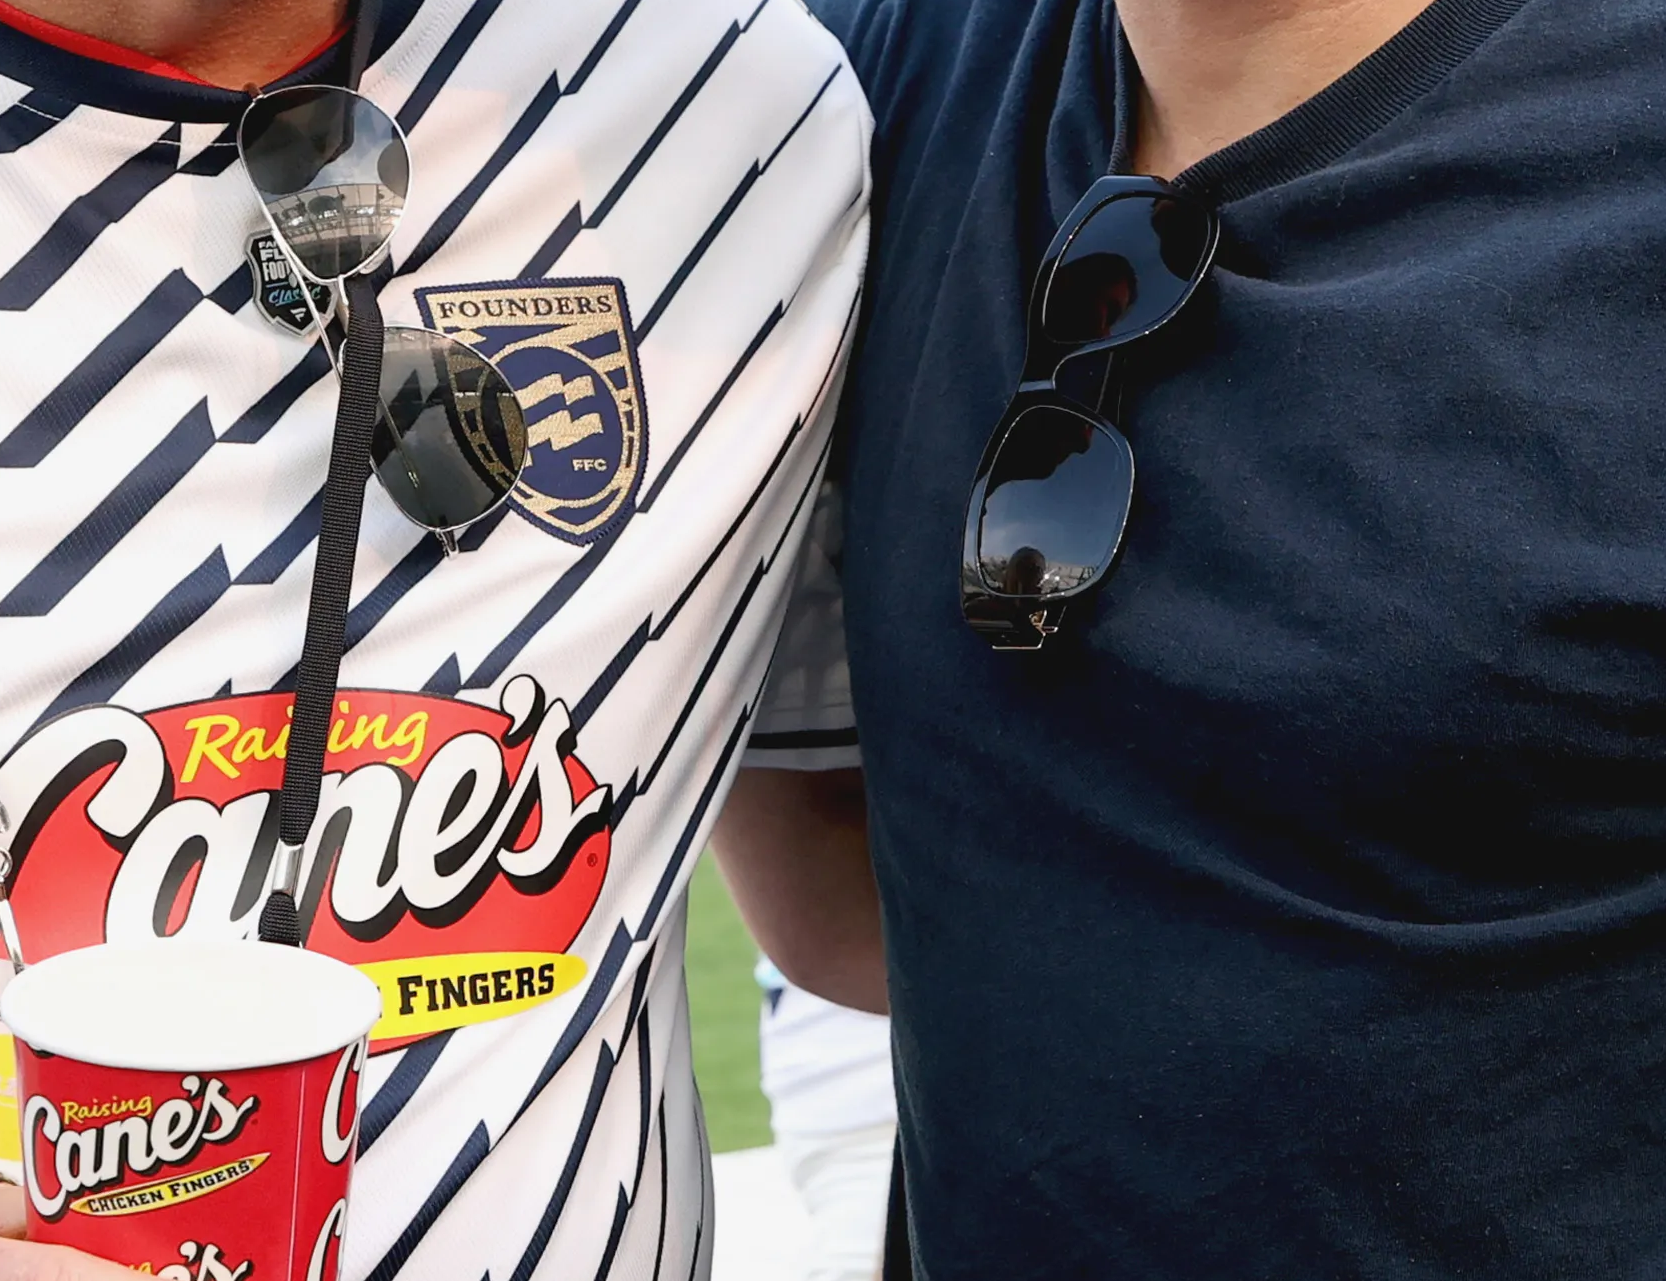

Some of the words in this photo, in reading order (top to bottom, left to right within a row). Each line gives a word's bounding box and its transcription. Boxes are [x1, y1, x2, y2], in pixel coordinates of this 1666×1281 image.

[436, 293, 614, 320] FOUNDERS
[572, 456, 608, 472] FFC
[180, 700, 429, 783] Raiing
[397, 963, 554, 1016] FINGERS
[61, 1096, 153, 1125] Raising
[23, 1074, 257, 1218] Cane's
[87, 1188, 164, 1215] CHICKEN
[170, 1158, 251, 1199] FINGERS
